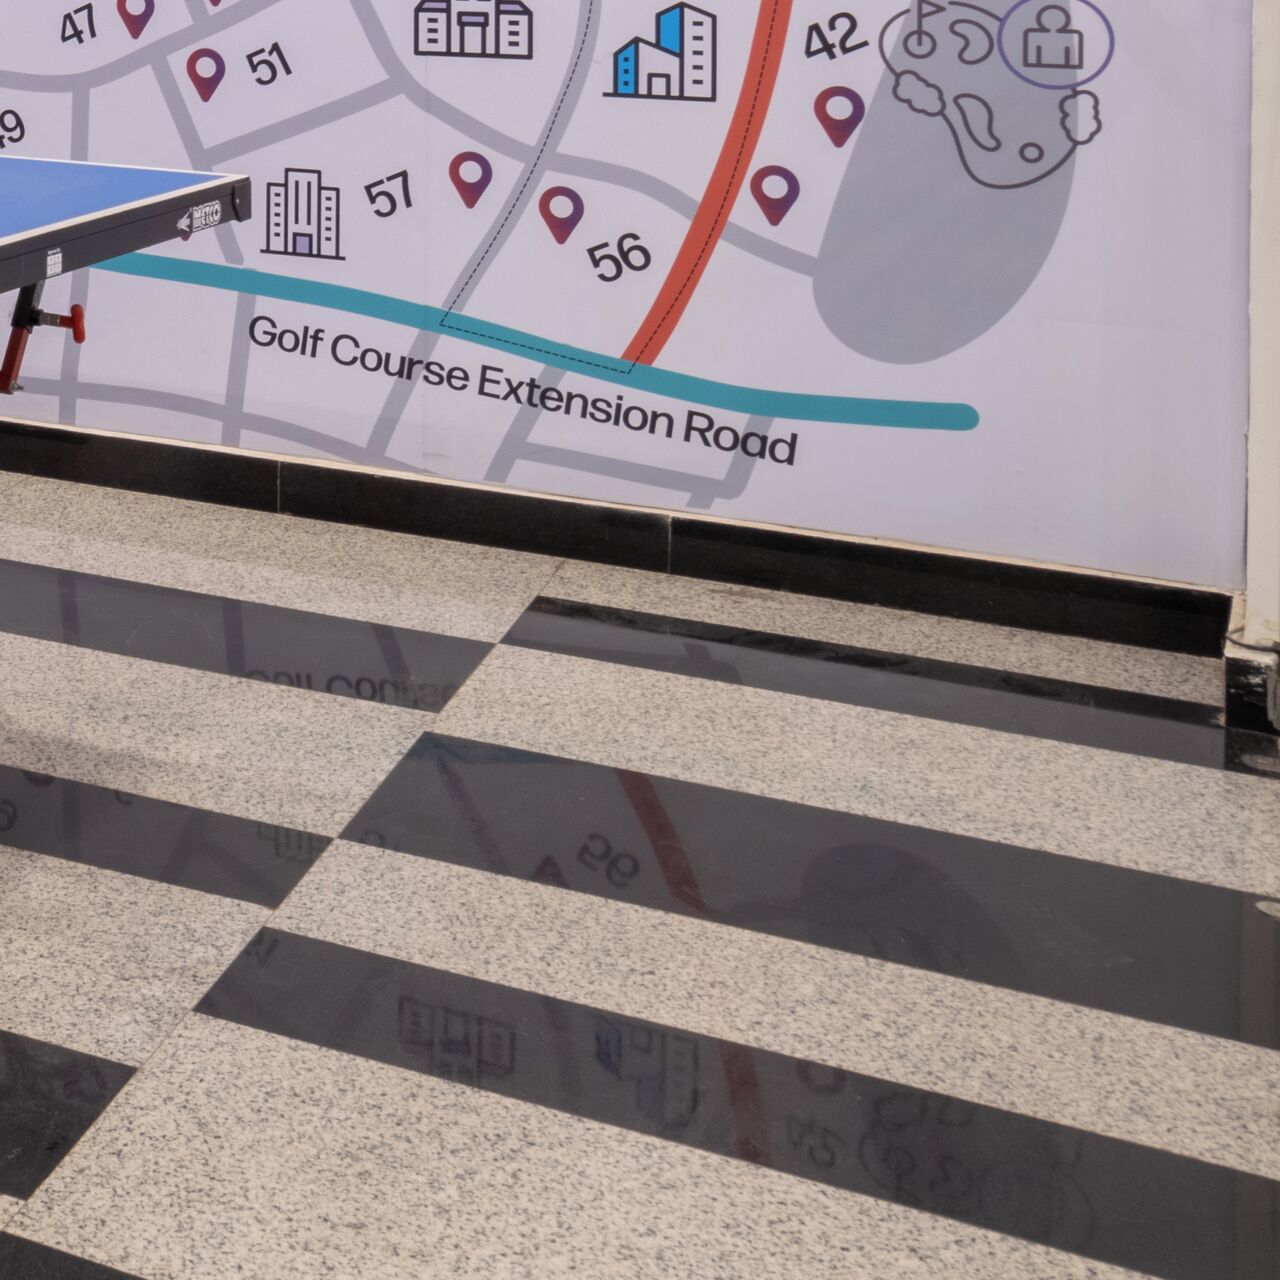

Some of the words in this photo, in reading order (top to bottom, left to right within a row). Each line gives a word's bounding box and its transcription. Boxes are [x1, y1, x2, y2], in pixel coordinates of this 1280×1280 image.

[59, 3, 99, 48] 47
[803, 12, 869, 62] 42
[246, 42, 293, 85] 51
[192, 200, 222, 232] METCO
[364, 170, 413, 218] 57
[587, 233, 652, 283] 56
[248, 314, 324, 358] Golf
[331, 331, 470, 392] Course
[479, 366, 674, 441] Extension
[685, 410, 798, 467] Road
